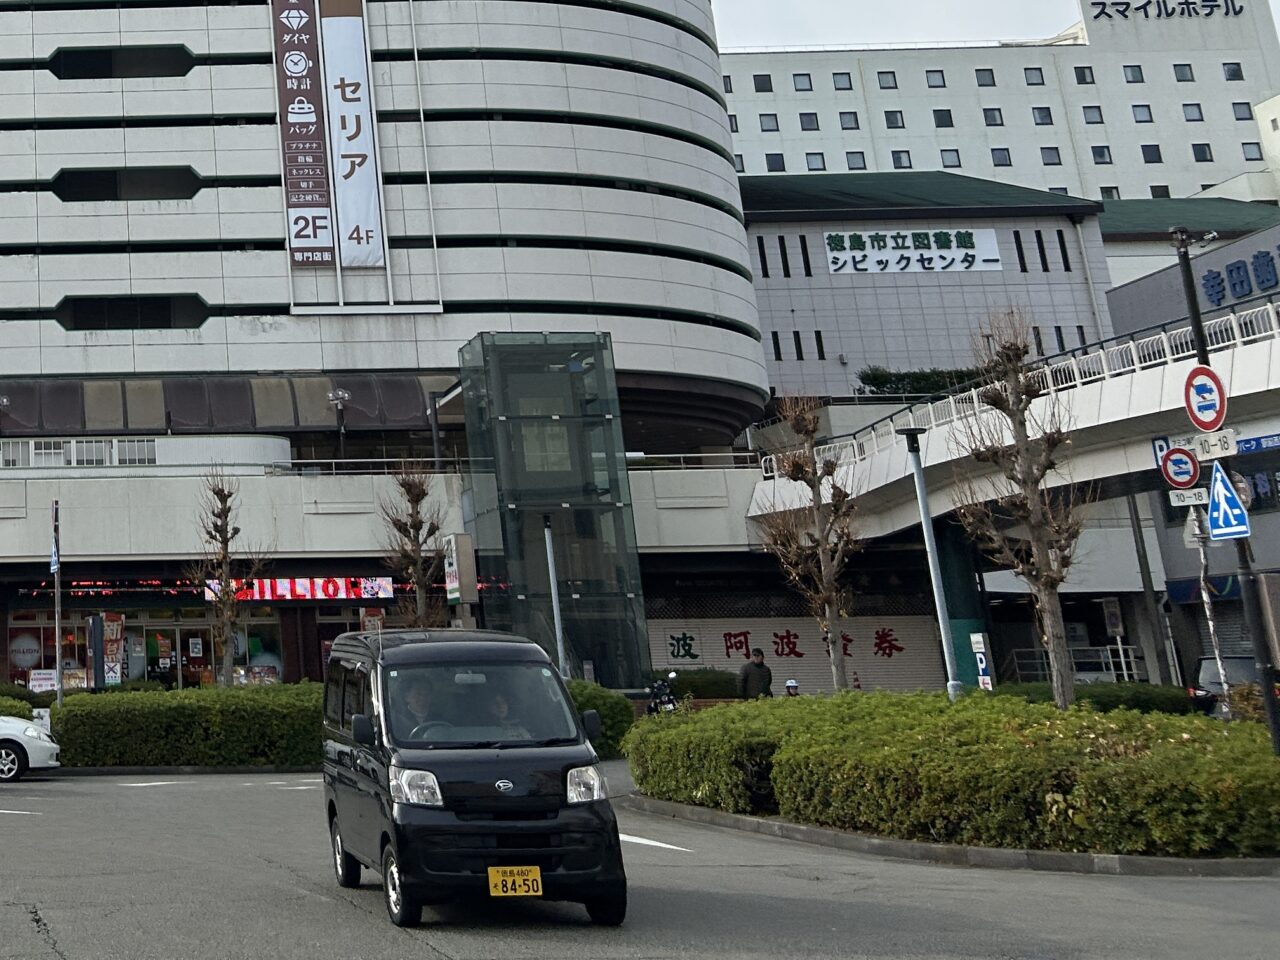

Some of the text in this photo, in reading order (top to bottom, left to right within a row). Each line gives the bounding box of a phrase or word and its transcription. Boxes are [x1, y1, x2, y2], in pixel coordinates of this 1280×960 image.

[282, 33, 310, 45] ダイヤ
[286, 78, 312, 90] 時計
[333, 77, 368, 180] セリア
[293, 215, 328, 239] 2F
[348, 225, 374, 245] 4F
[826, 231, 975, 252] 徳島市立図書館
[294, 252, 332, 263] 専門店街
[831, 253, 1000, 272] シビックセンター
[1202, 244, 1280, 307] 幸田歯
[1154, 439, 1168, 466] P
[976, 653, 986, 676] P
